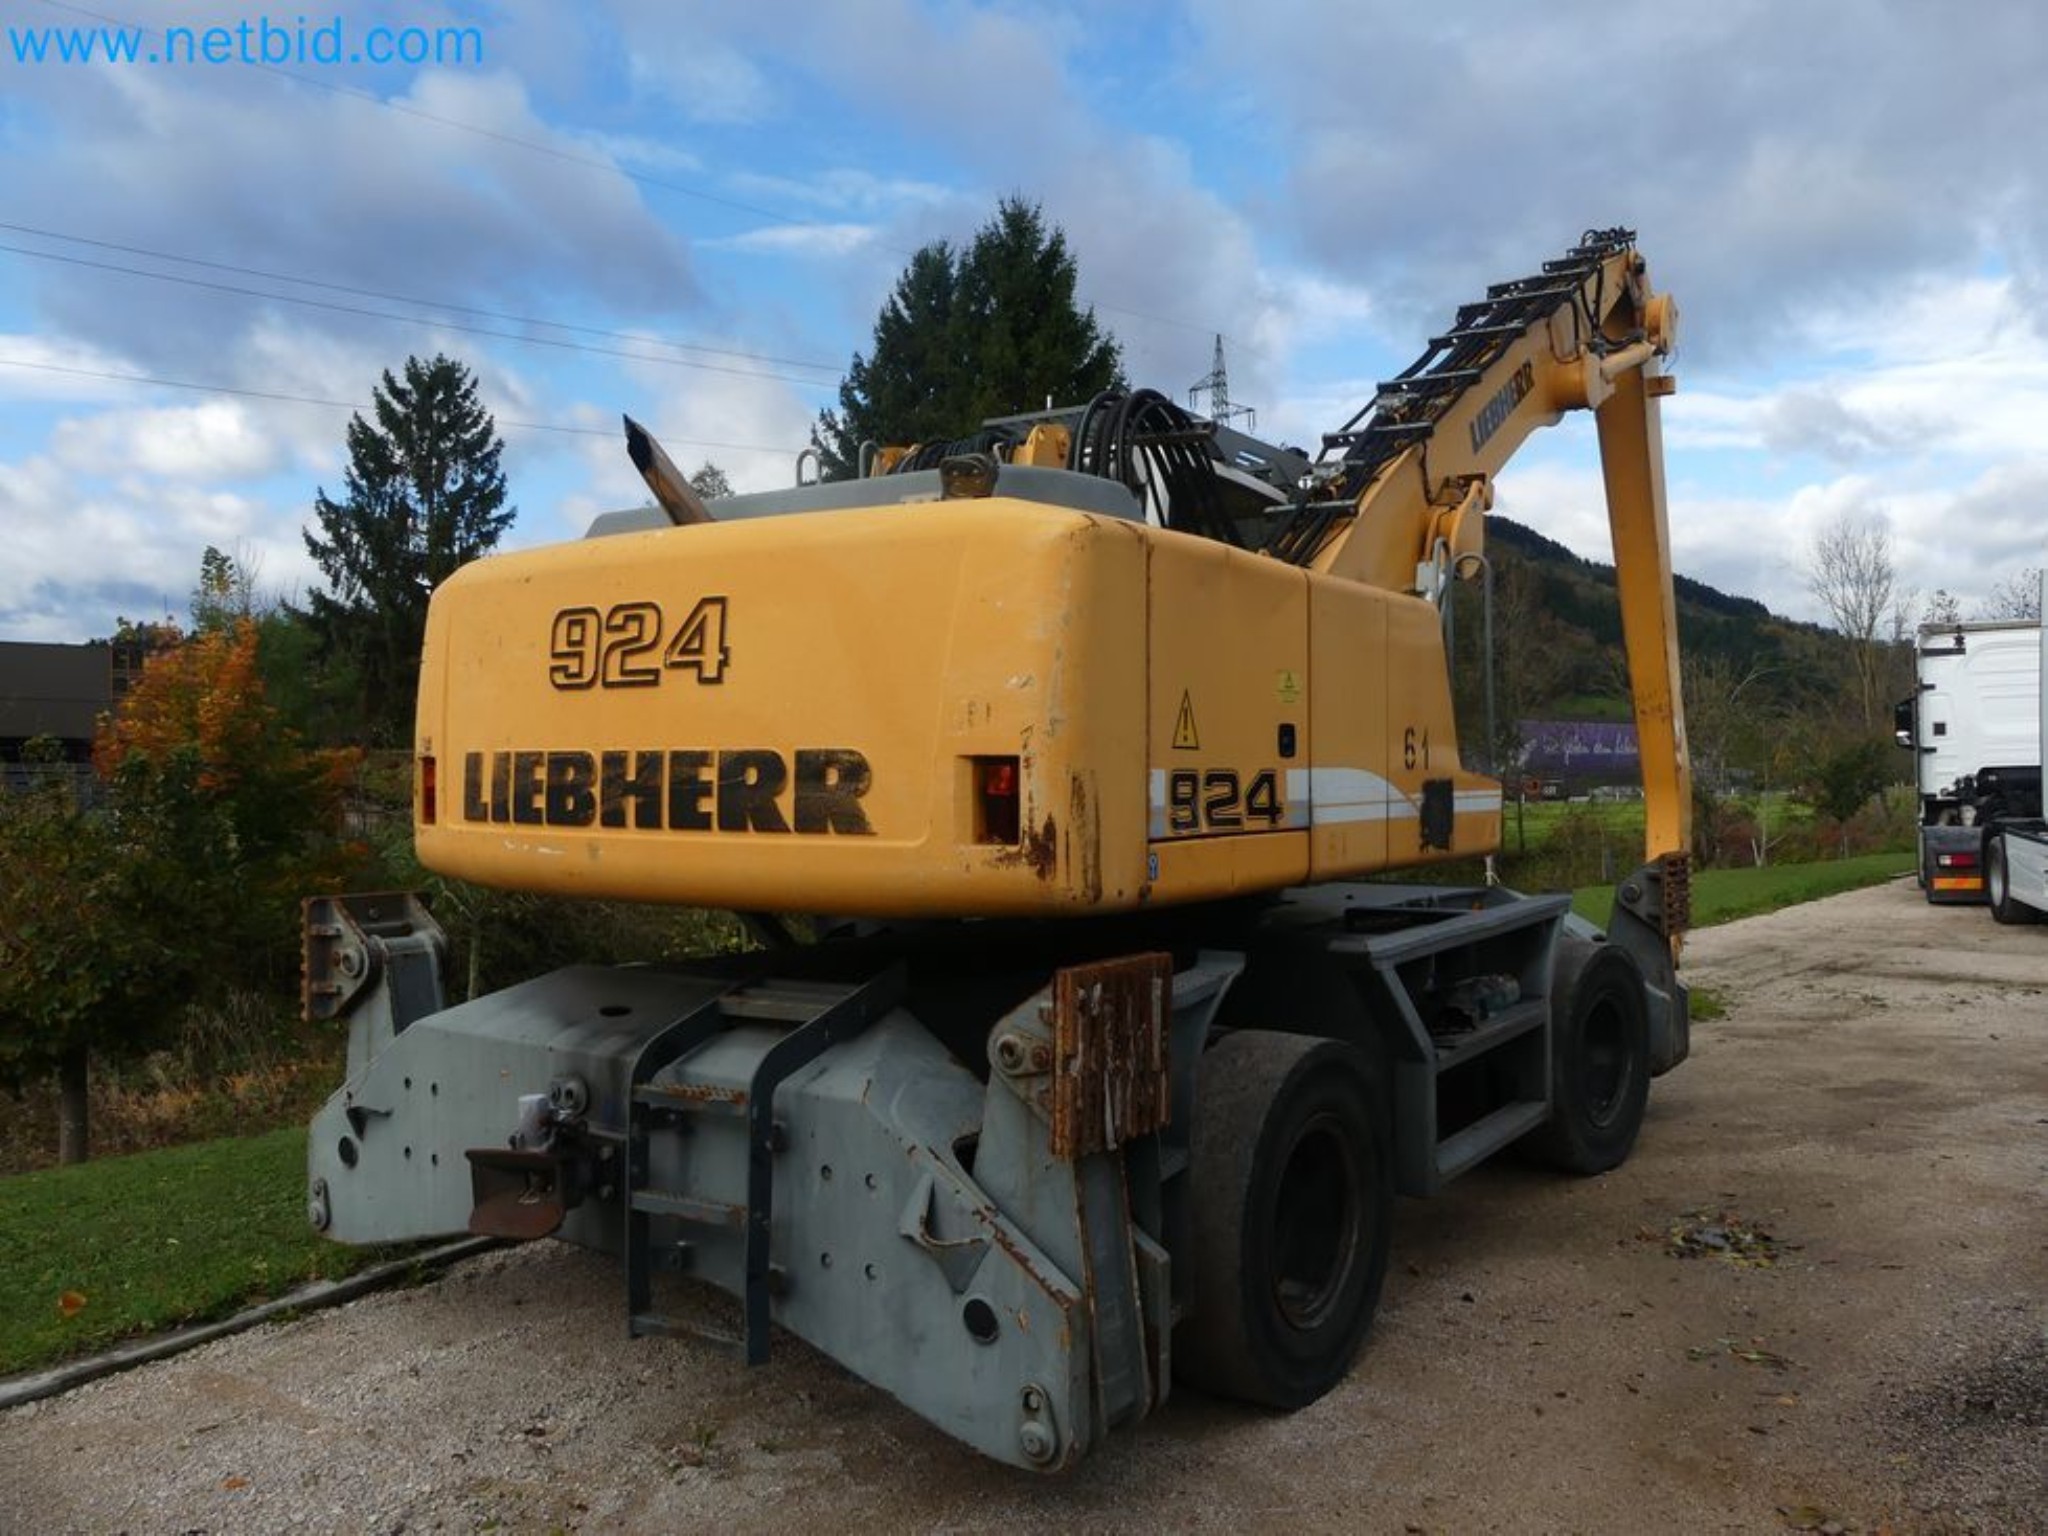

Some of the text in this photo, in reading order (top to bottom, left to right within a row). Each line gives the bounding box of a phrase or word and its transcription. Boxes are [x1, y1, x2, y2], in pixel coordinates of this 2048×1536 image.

[1469, 359, 1535, 455] LIEBHERR
[549, 596, 730, 690] 924
[463, 748, 877, 836] LIEBHERR
[1170, 768, 1284, 834] 924
